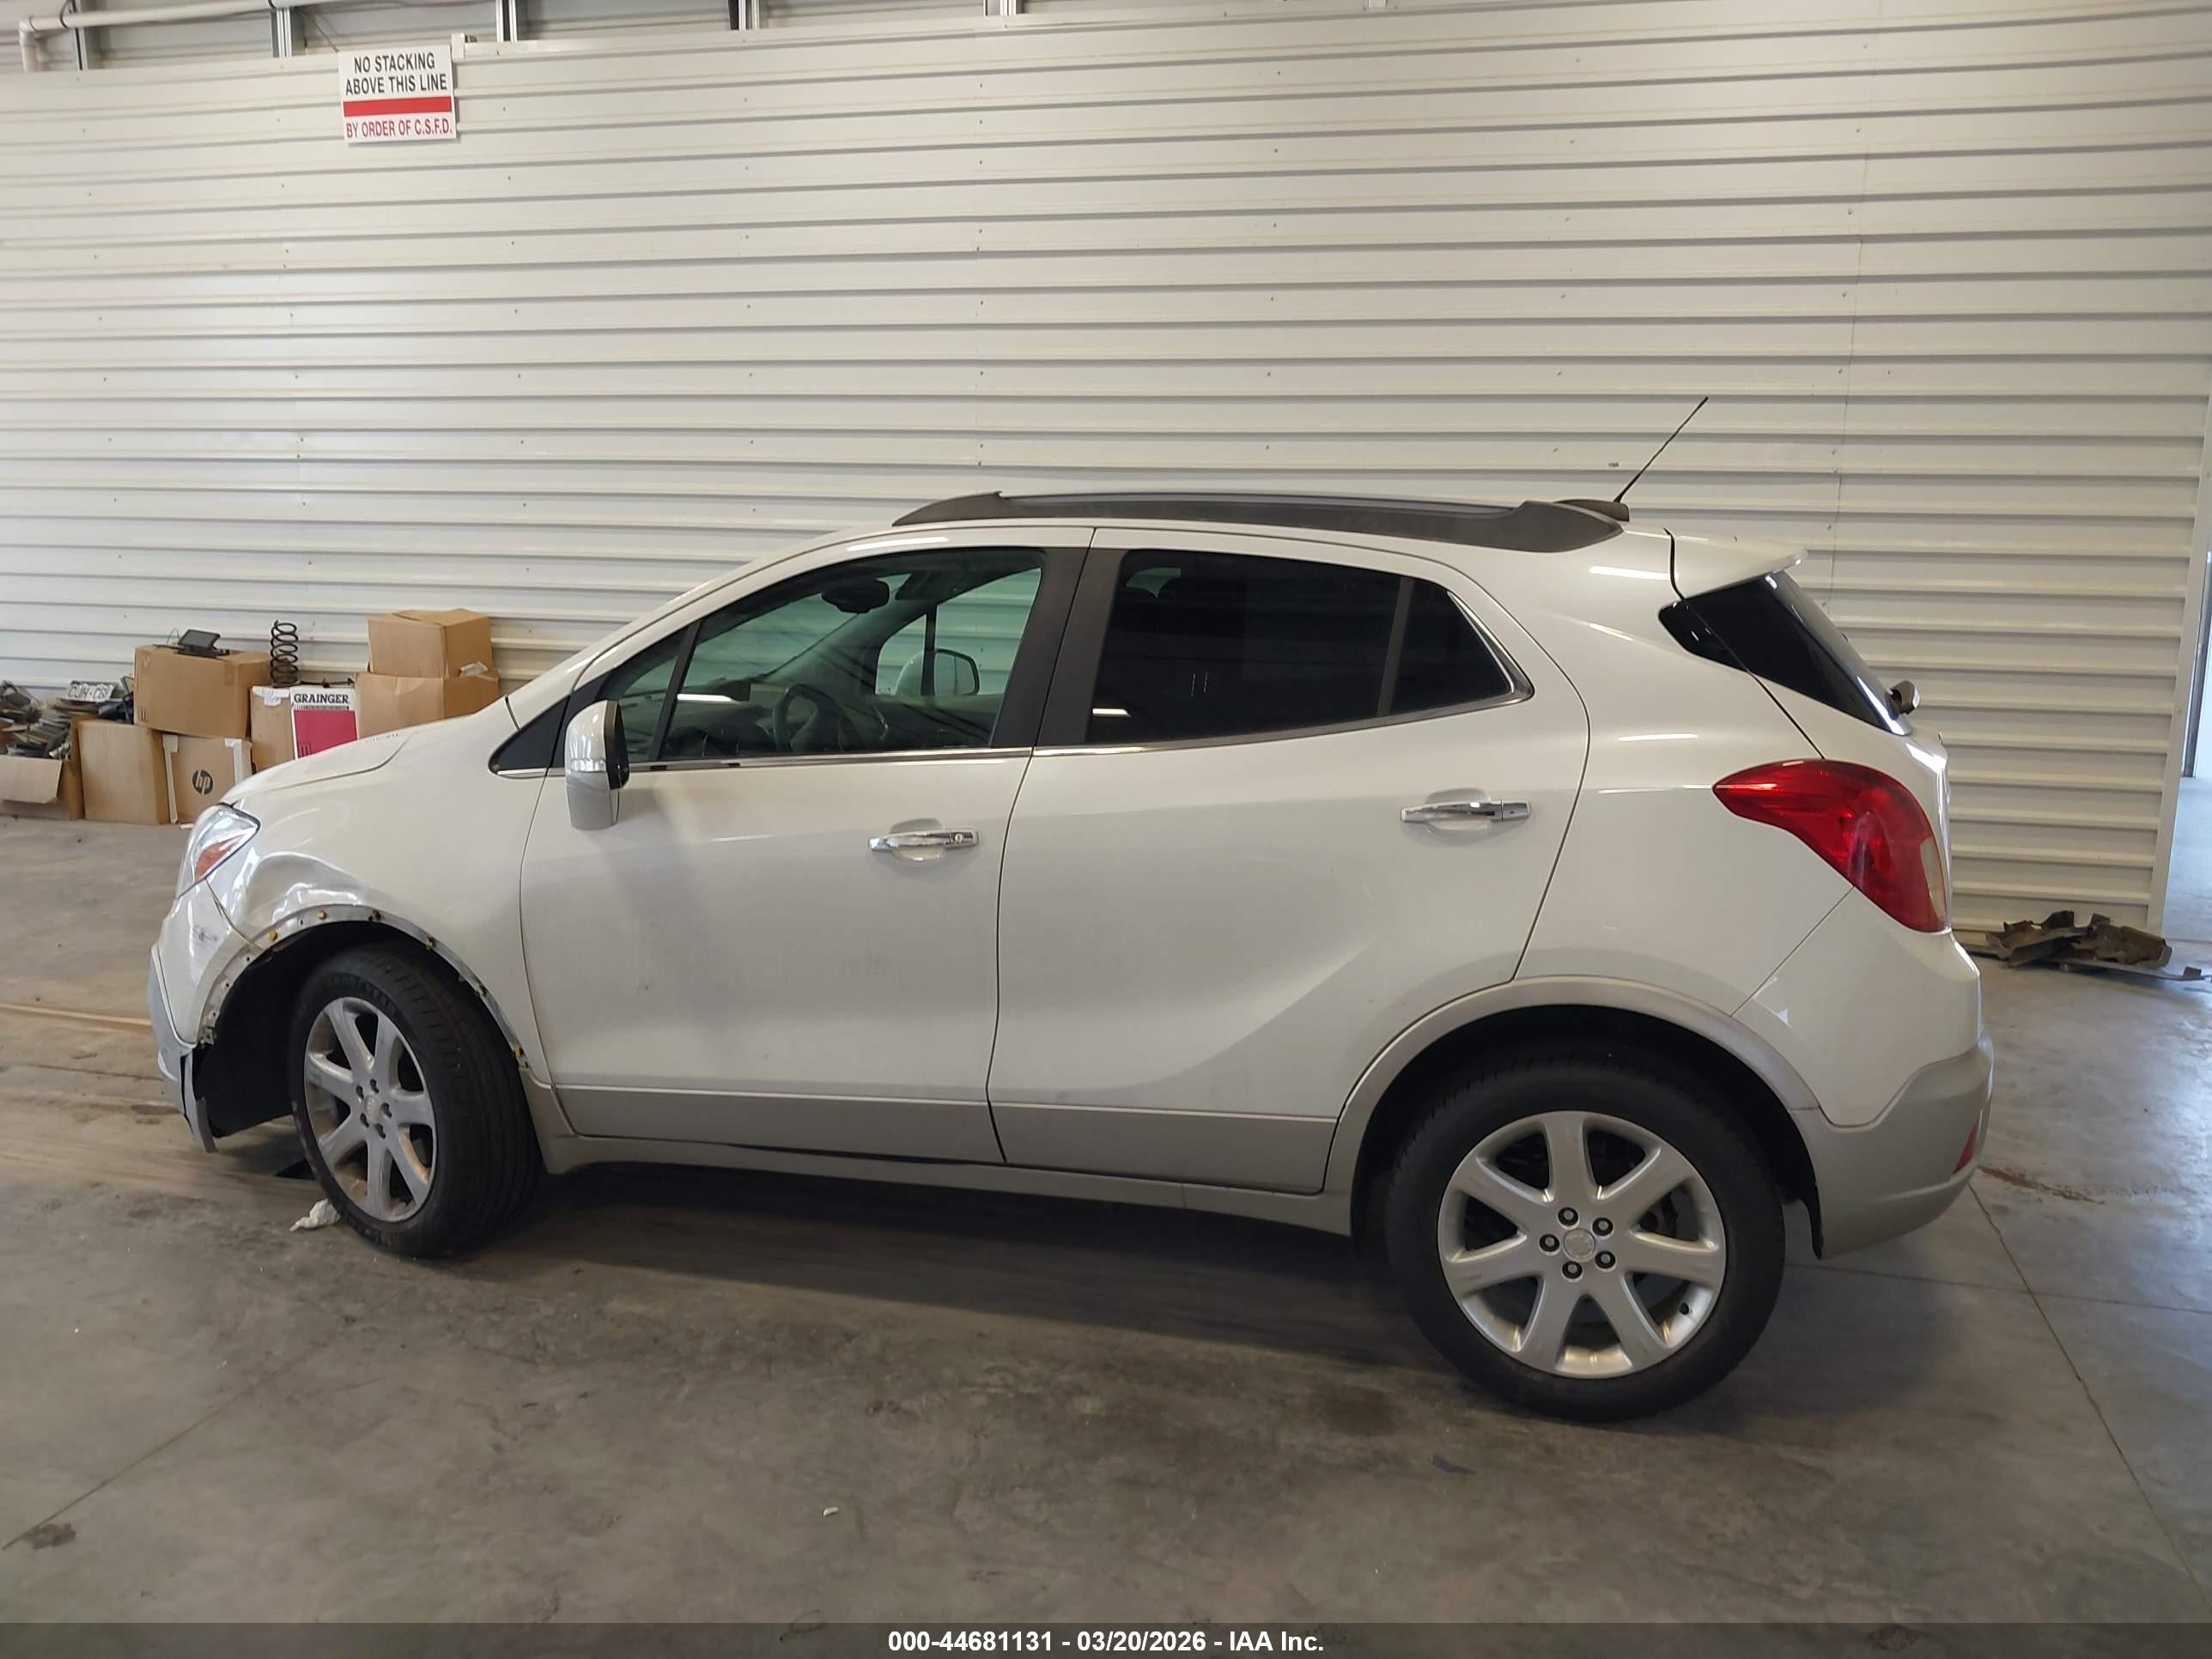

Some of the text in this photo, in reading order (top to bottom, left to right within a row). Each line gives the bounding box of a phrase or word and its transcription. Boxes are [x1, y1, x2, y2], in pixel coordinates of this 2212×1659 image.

[354, 52, 435, 74] NO STACKING
[345, 73, 447, 96] ABOVE THIS LINE
[346, 118, 453, 138] BY ORDER OF C.S.F.D.
[294, 693, 349, 704] GRAINGER
[194, 769, 212, 795] hp
